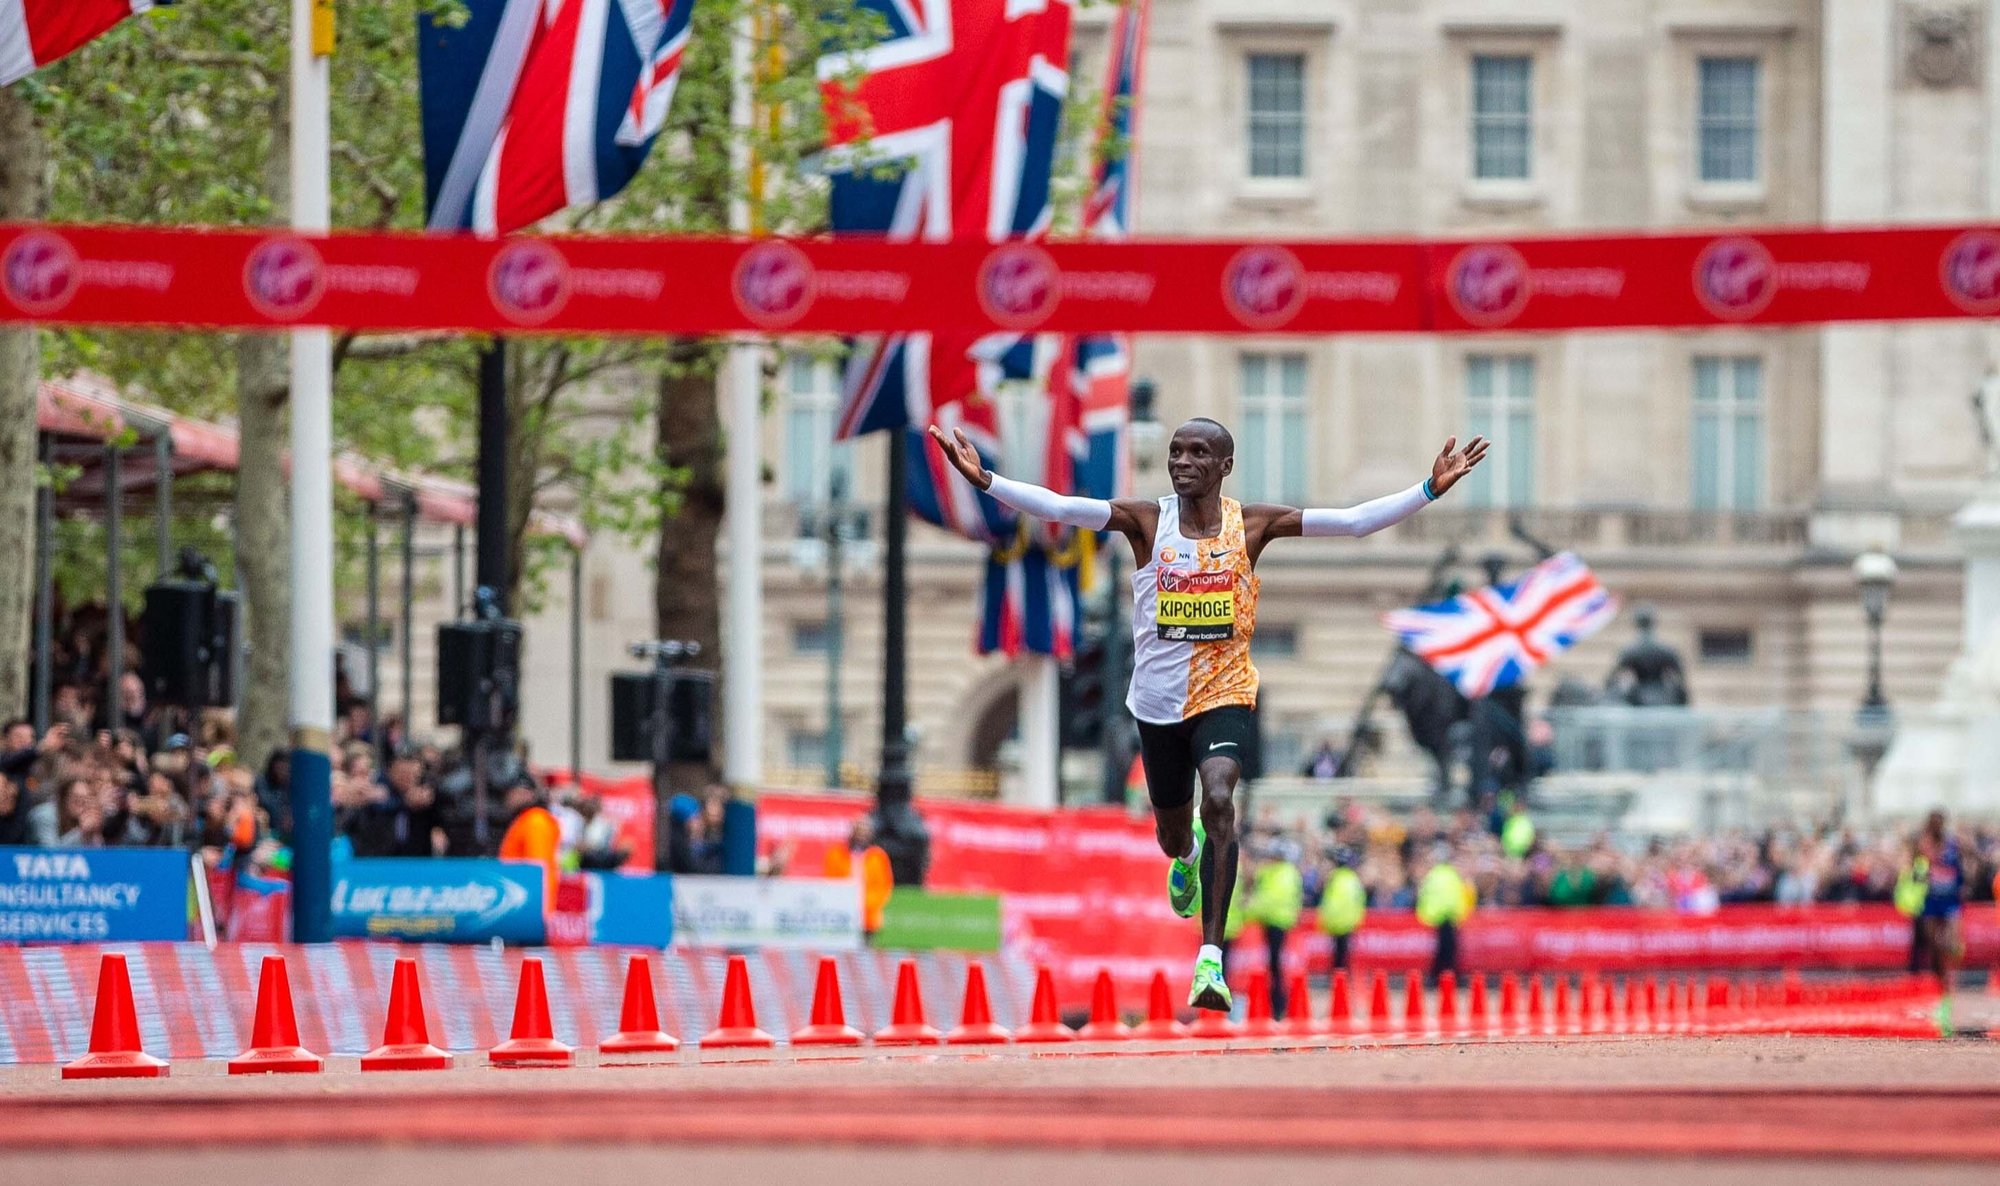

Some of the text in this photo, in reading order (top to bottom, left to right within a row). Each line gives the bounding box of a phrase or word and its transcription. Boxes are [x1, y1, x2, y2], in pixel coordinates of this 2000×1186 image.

[1178, 552, 1190, 560] NN
[1191, 574, 1230, 586] money
[1160, 600, 1231, 618] KIPCHOGE
[13, 854, 91, 881] TATA
